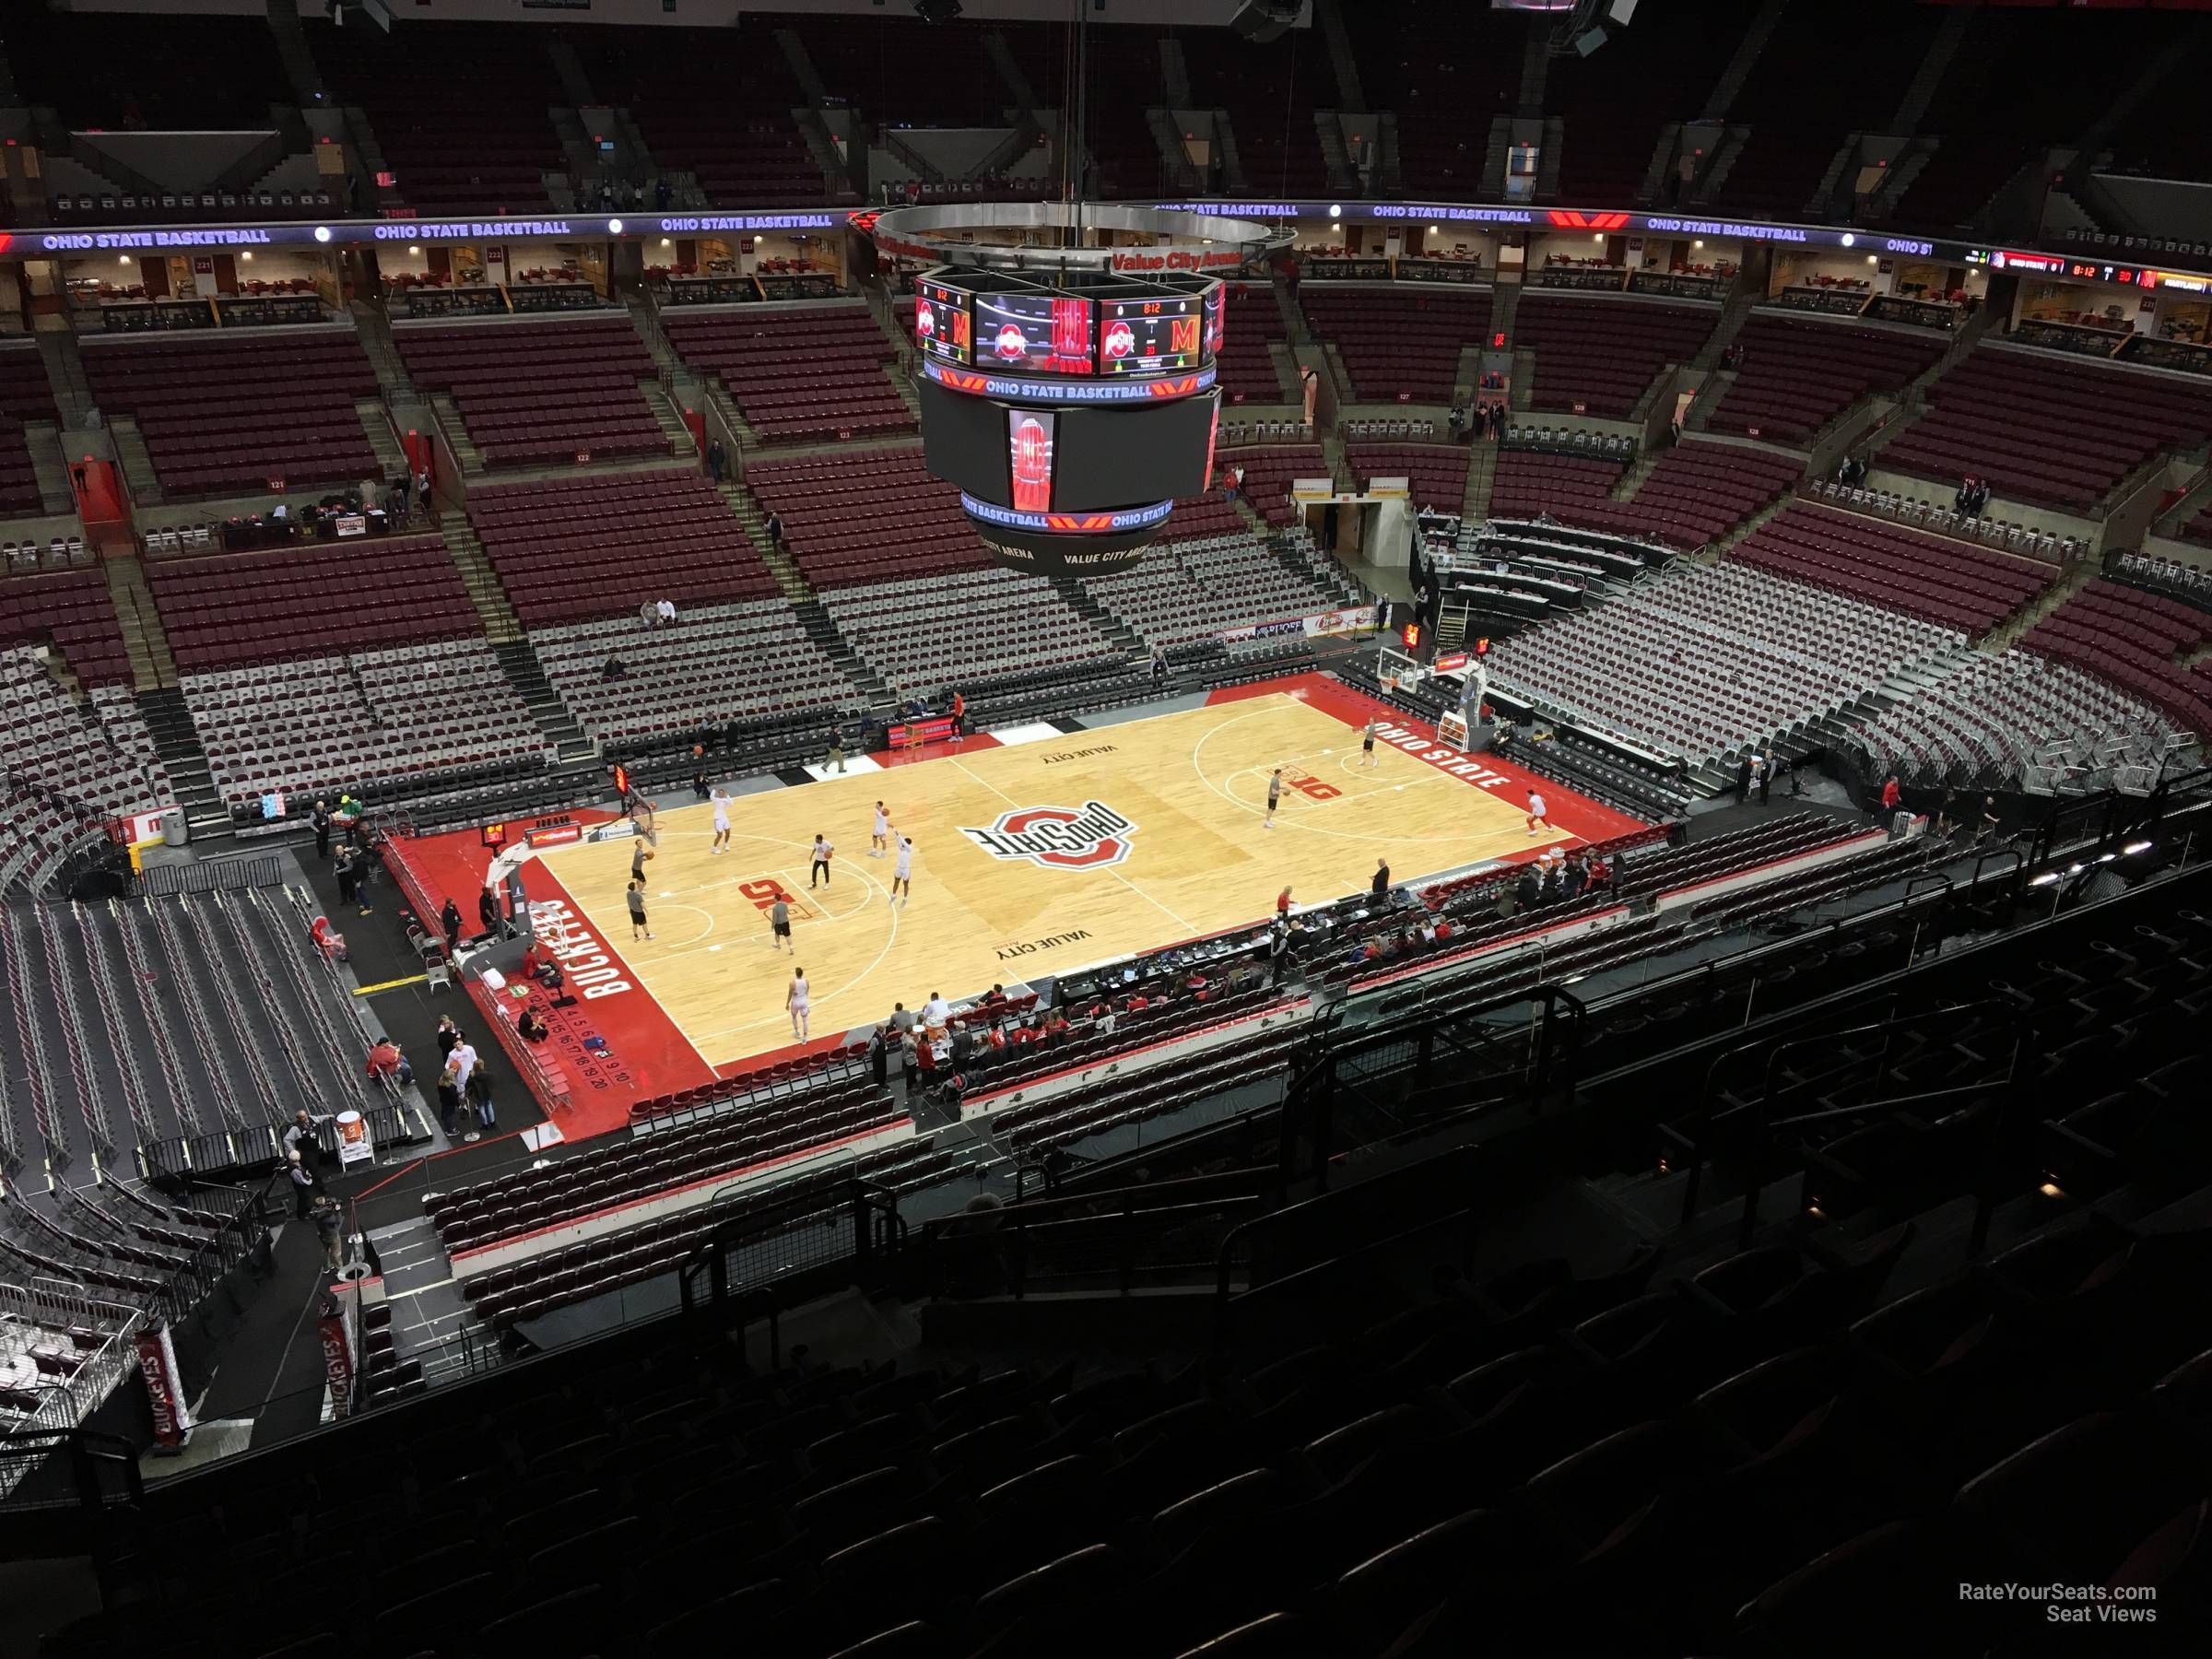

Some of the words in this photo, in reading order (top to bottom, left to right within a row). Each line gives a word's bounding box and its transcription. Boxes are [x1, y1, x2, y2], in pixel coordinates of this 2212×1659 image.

[1221, 205, 1298, 216] BASKETBALL
[1373, 206, 1406, 218] OHIO
[1408, 206, 1446, 218] STATE
[1449, 208, 1531, 222] BASKETBALL
[662, 218, 698, 230] OHIO
[701, 218, 743, 229] STATE
[747, 216, 832, 229] BASKETBALL
[375, 226, 417, 239] OHIO
[420, 224, 467, 237] STATE
[472, 222, 570, 235] BASKETBALL
[1648, 218, 1680, 230] OHIO
[1682, 220, 1722, 234] STATE
[1724, 224, 1806, 242] BASKETBALL
[43, 236, 92, 249] OHIO
[96, 233, 152, 247] STATE
[156, 230, 270, 245] BASKETBALL
[1888, 240, 1917, 253] OHIO
[1112, 253, 1165, 270] Value
[1167, 252, 1202, 272] City
[1205, 251, 1243, 266] Arena
[2051, 264, 2057, 272] 0
[2073, 265, 2095, 276] 8:12
[2119, 271, 2131, 282] 30
[1117, 306, 1124, 315] 0
[1144, 303, 1160, 313] 8:12
[1180, 302, 1186, 312] 0
[1171, 320, 1195, 351] M
[986, 381, 1018, 394] OHIO
[1022, 384, 1064, 398] STATE
[1067, 383, 1152, 398] BASKETBALL
[577, 453, 590, 462] 122
[979, 505, 1048, 527] BASKETBALL
[1112, 511, 1139, 527] OHIO
[1142, 505, 1165, 522] STATE
[1002, 545, 1035, 560] ARENA
[1065, 552, 1100, 564] VALUE
[1102, 549, 1125, 563] CITY
[1042, 752, 1076, 765] CITY
[1073, 746, 1119, 759] VALUE
[1366, 722, 1431, 751] OHIO
[1422, 748, 1511, 788] STATE
[488, 832, 500, 841] 30
[1035, 930, 1093, 949] VALUE
[996, 943, 1038, 960] CITY
[545, 1013, 558, 1024] 14
[573, 1018, 587, 1028] 5
[551, 1023, 564, 1033] 15
[582, 1030, 594, 1038] 6
[559, 1035, 573, 1045] 16
[567, 1045, 582, 1055] 17
[575, 1056, 589, 1066] 18
[606, 1061, 619, 1070] 9
[583, 1066, 598, 1077] 19
[615, 1072, 629, 1083] 10
[591, 1077, 608, 1089] 20
[323, 1338, 350, 1416] BUCKEYES
[142, 1356, 171, 1434] BUCKEYES
